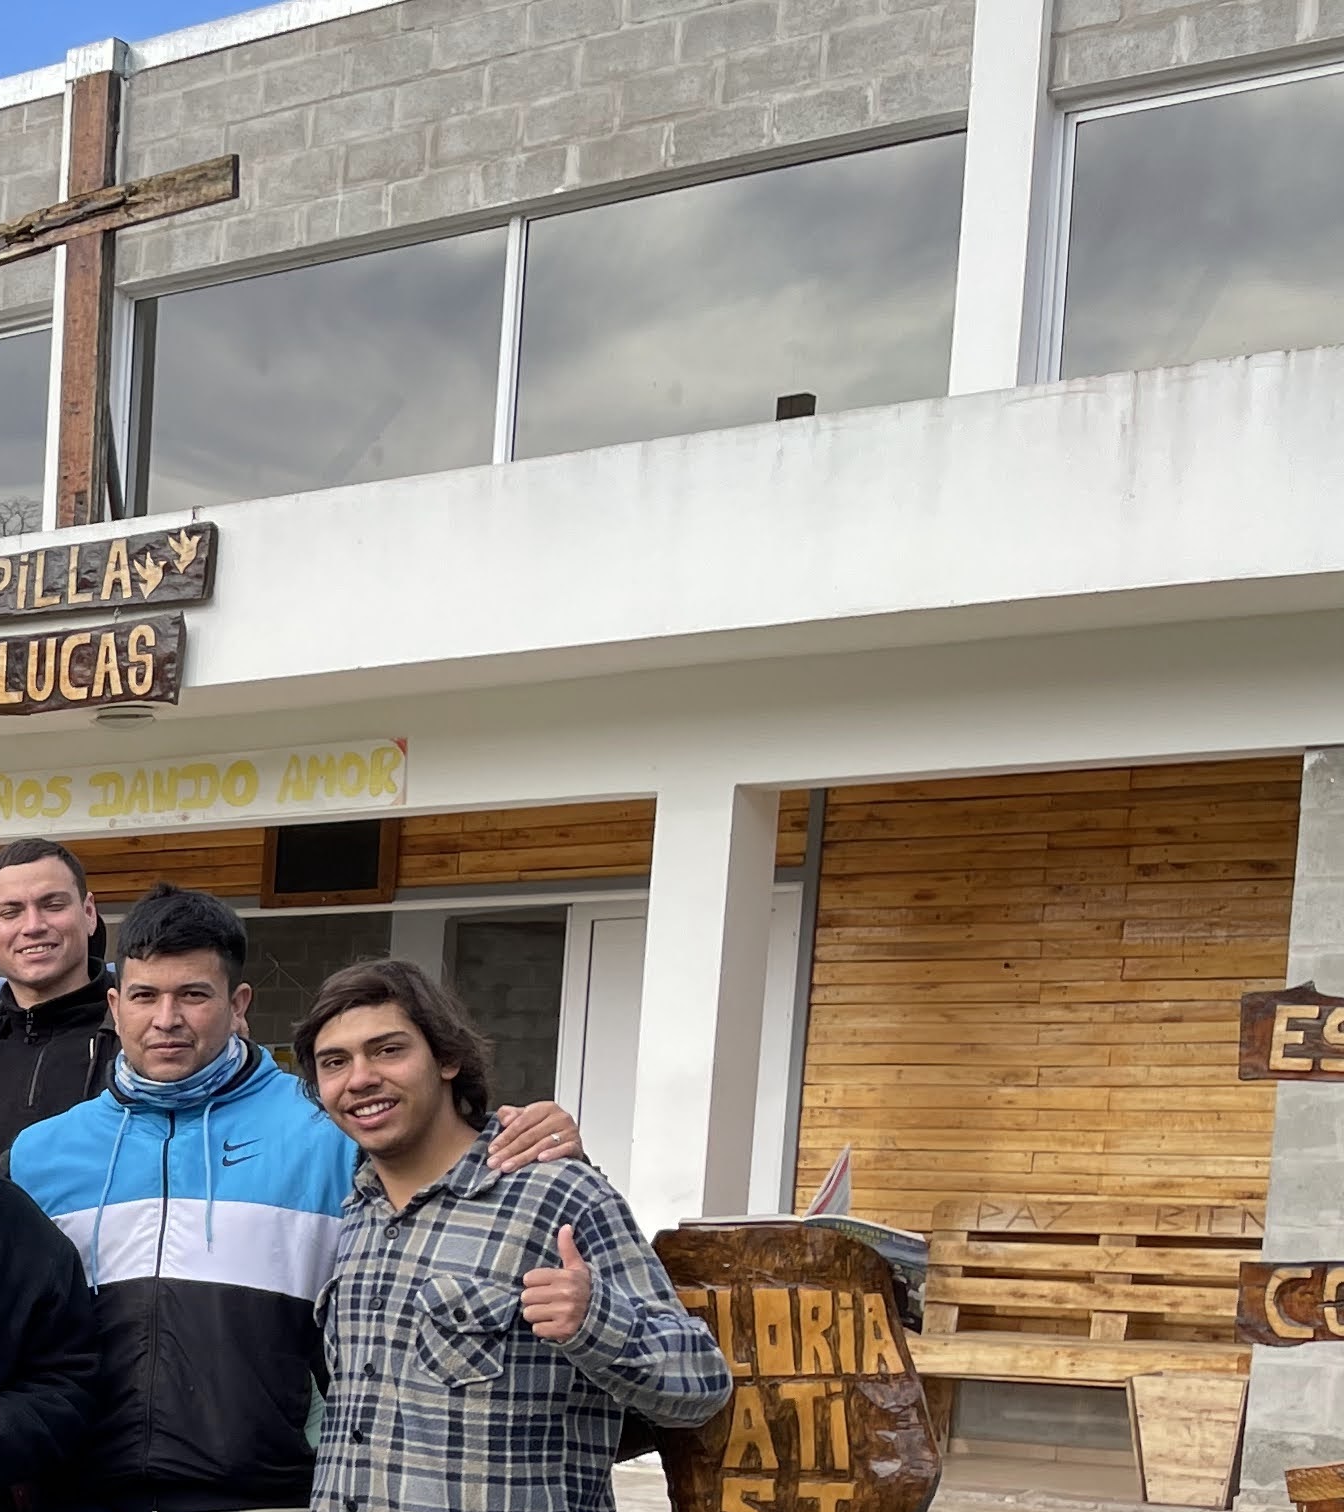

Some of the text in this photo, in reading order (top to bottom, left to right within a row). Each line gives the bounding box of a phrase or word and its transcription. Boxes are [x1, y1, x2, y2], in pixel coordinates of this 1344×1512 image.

[89, 759, 258, 817] DANDO
[279, 746, 401, 805] AMOR
[721, 1384, 779, 1470] A
